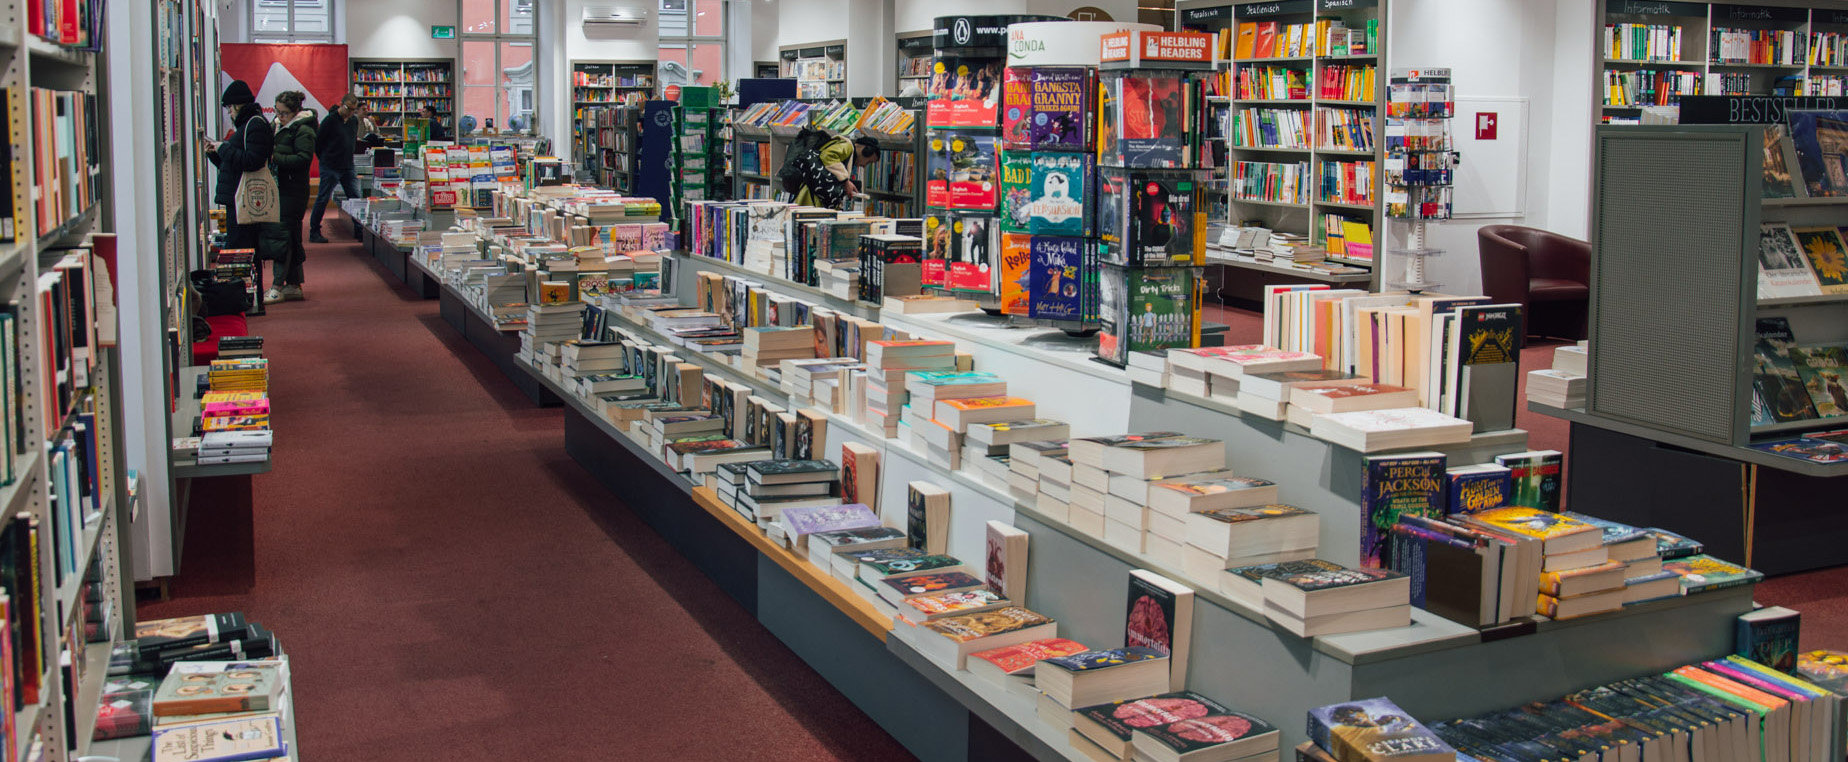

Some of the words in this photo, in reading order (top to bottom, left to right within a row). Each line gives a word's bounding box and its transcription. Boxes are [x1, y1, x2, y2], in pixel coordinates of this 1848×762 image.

[1247, 4, 1280, 15] Italienisch
[1623, 1, 1671, 14] Informatik
[1729, 5, 1773, 19] Informatik
[1011, 30, 1025, 40] ANA
[1014, 40, 1045, 52] CONDA
[1161, 36, 1206, 48] HELBLING
[1161, 48, 1202, 59] READERS
[1035, 82, 1081, 92] GANGSTA
[1034, 92, 1081, 105] GRANNY
[1003, 166, 1024, 184] BAD
[1033, 203, 1081, 215] PERSUASION
[1140, 286, 1159, 296] Dirty
[1161, 284, 1181, 292] Tricks
[1389, 466, 1431, 479] PERCY
[1377, 479, 1441, 498] JACKSON
[1461, 478, 1488, 500] HUNT
[201, 728, 218, 753] Things
